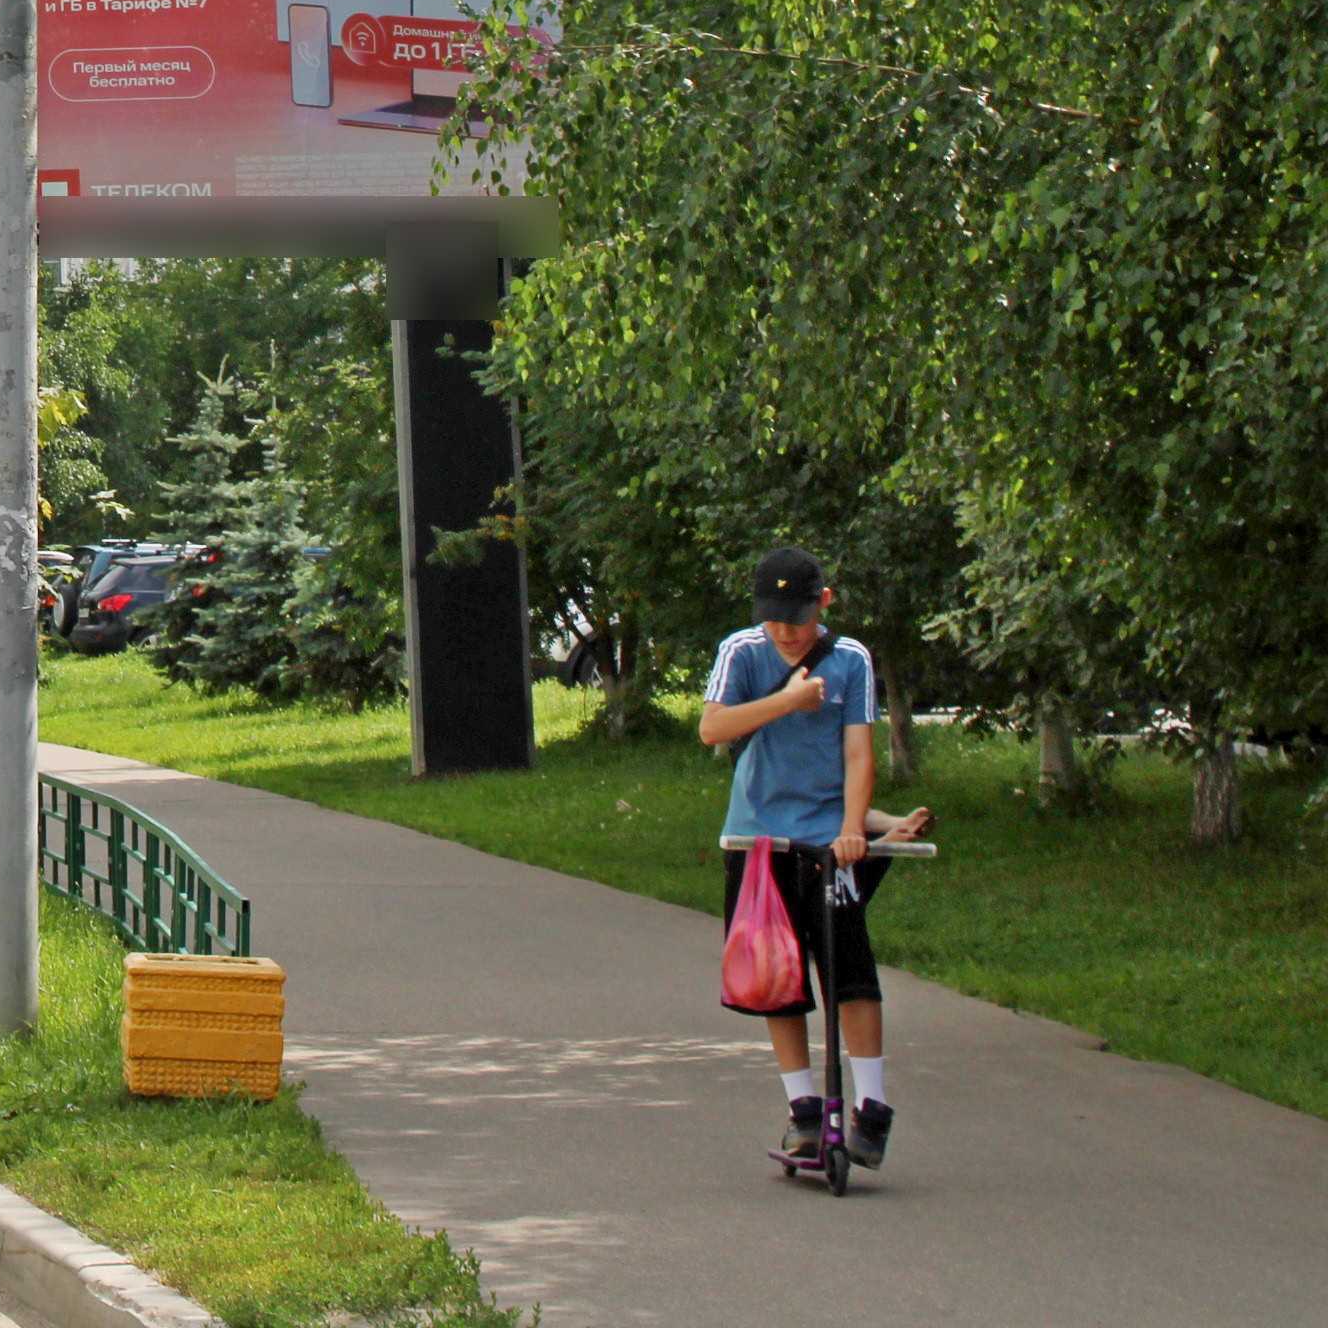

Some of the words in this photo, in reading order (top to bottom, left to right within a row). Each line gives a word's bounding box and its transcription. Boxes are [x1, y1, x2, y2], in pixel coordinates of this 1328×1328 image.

[45, 1, 56, 13] и
[60, 0, 83, 13] ГБ
[86, 0, 97, 12] в
[393, 43, 427, 62] до
[73, 60, 137, 75] Первый
[140, 61, 192, 74] месяц
[89, 74, 176, 89] бесплатно
